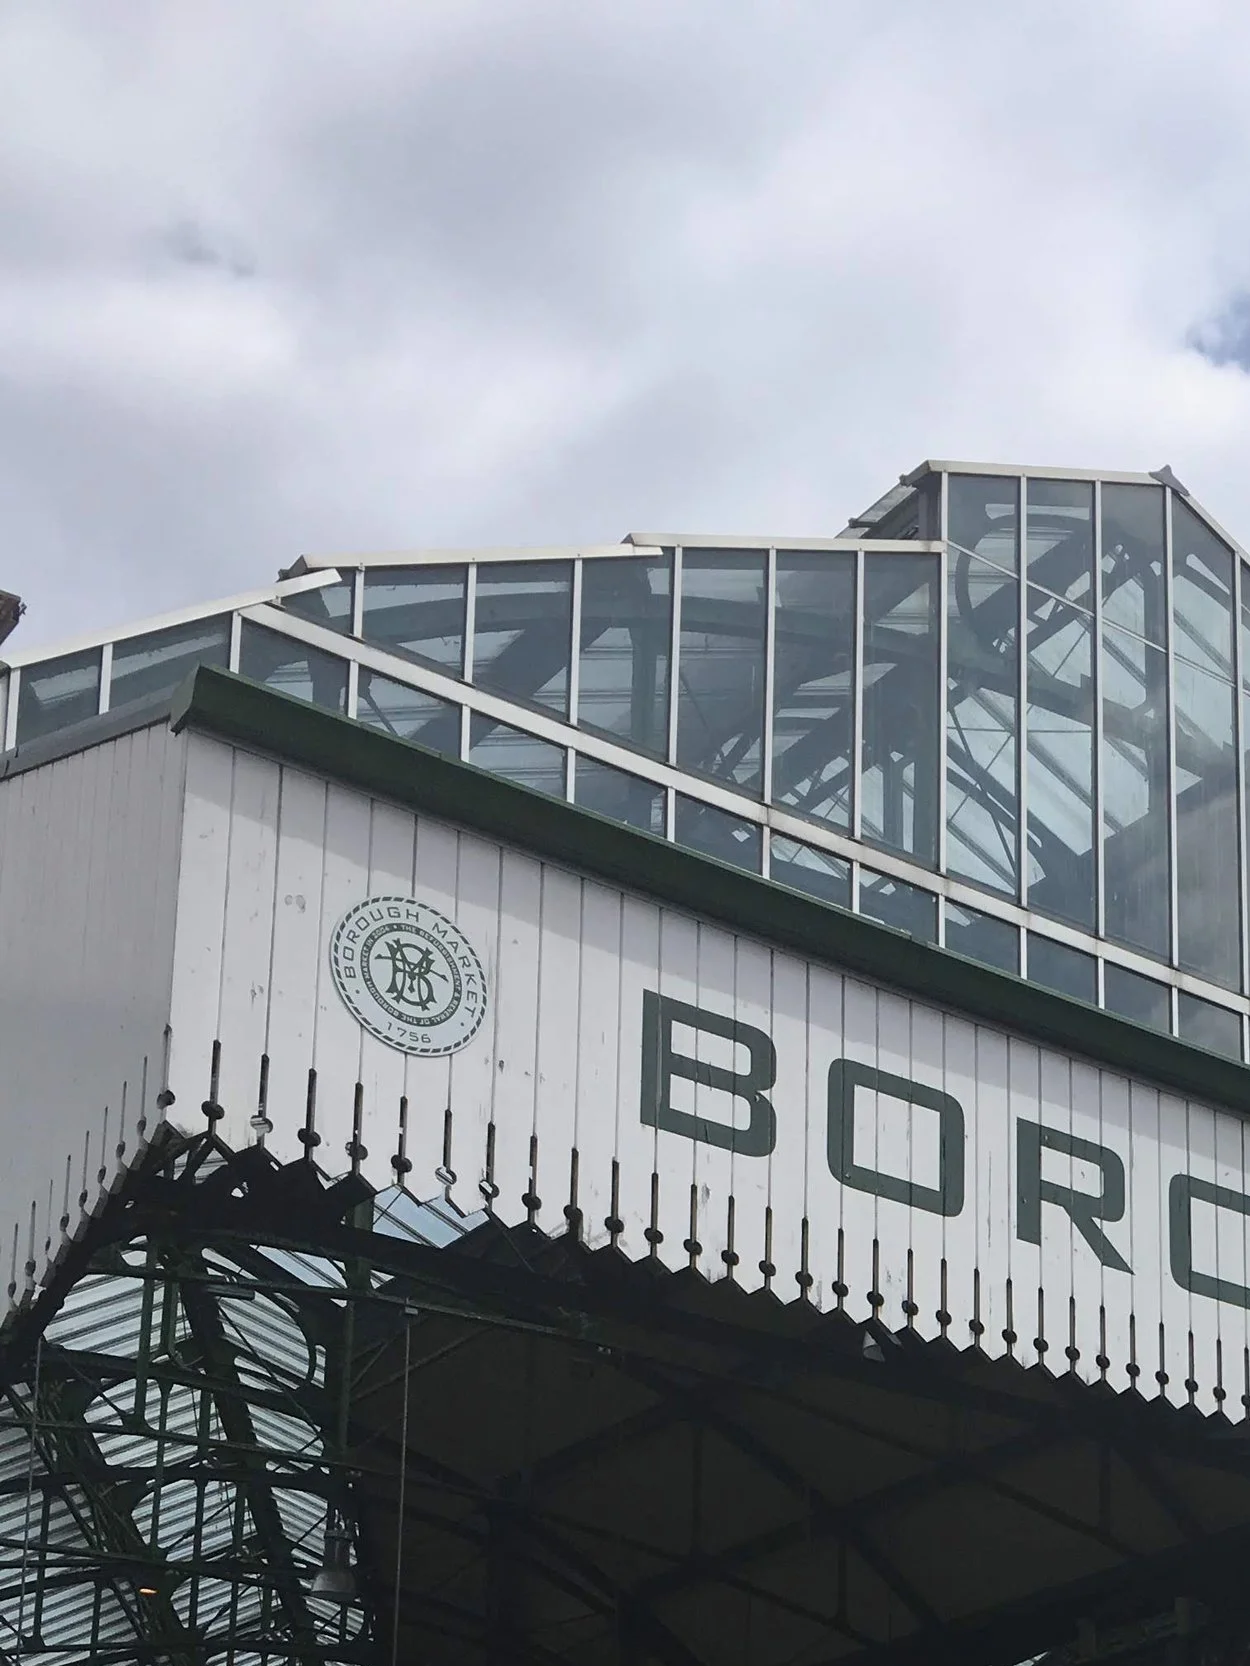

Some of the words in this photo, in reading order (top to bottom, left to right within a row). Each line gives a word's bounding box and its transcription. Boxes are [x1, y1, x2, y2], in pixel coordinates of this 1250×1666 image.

[343, 906, 419, 979] BOROUGH
[432, 922, 478, 1018] MARKET
[387, 1022, 431, 1044] 1756
